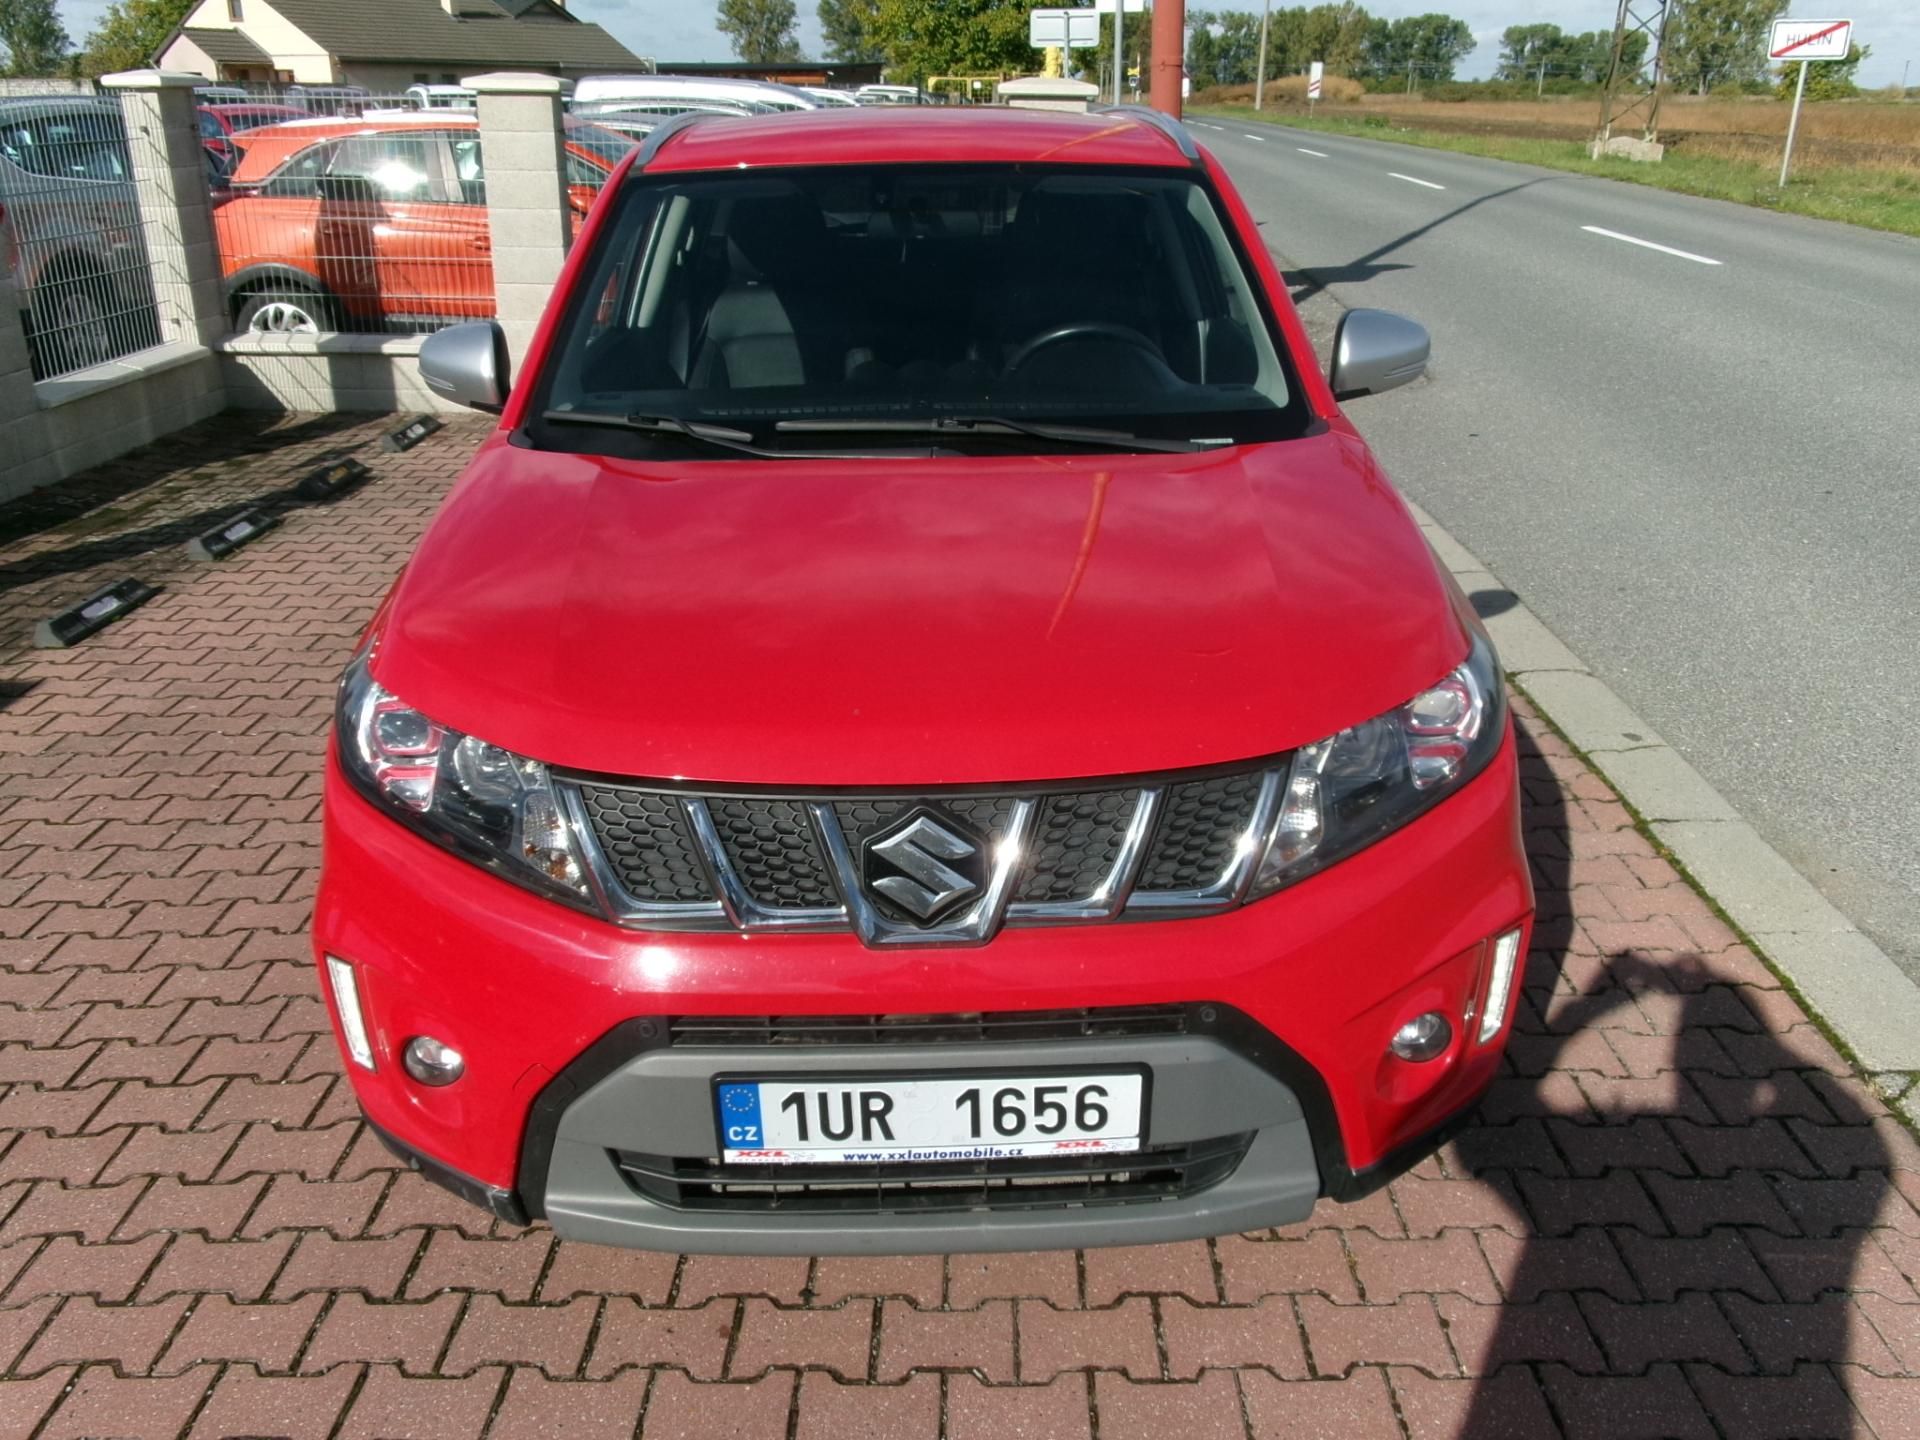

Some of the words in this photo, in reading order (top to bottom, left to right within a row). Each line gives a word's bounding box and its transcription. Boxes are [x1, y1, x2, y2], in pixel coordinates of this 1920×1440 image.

[781, 1091, 896, 1142] 1UR
[955, 1085, 1109, 1139] 1656
[728, 1126, 759, 1141] CZ
[842, 1147, 1024, 1162] www.xxlautomobile.cz
